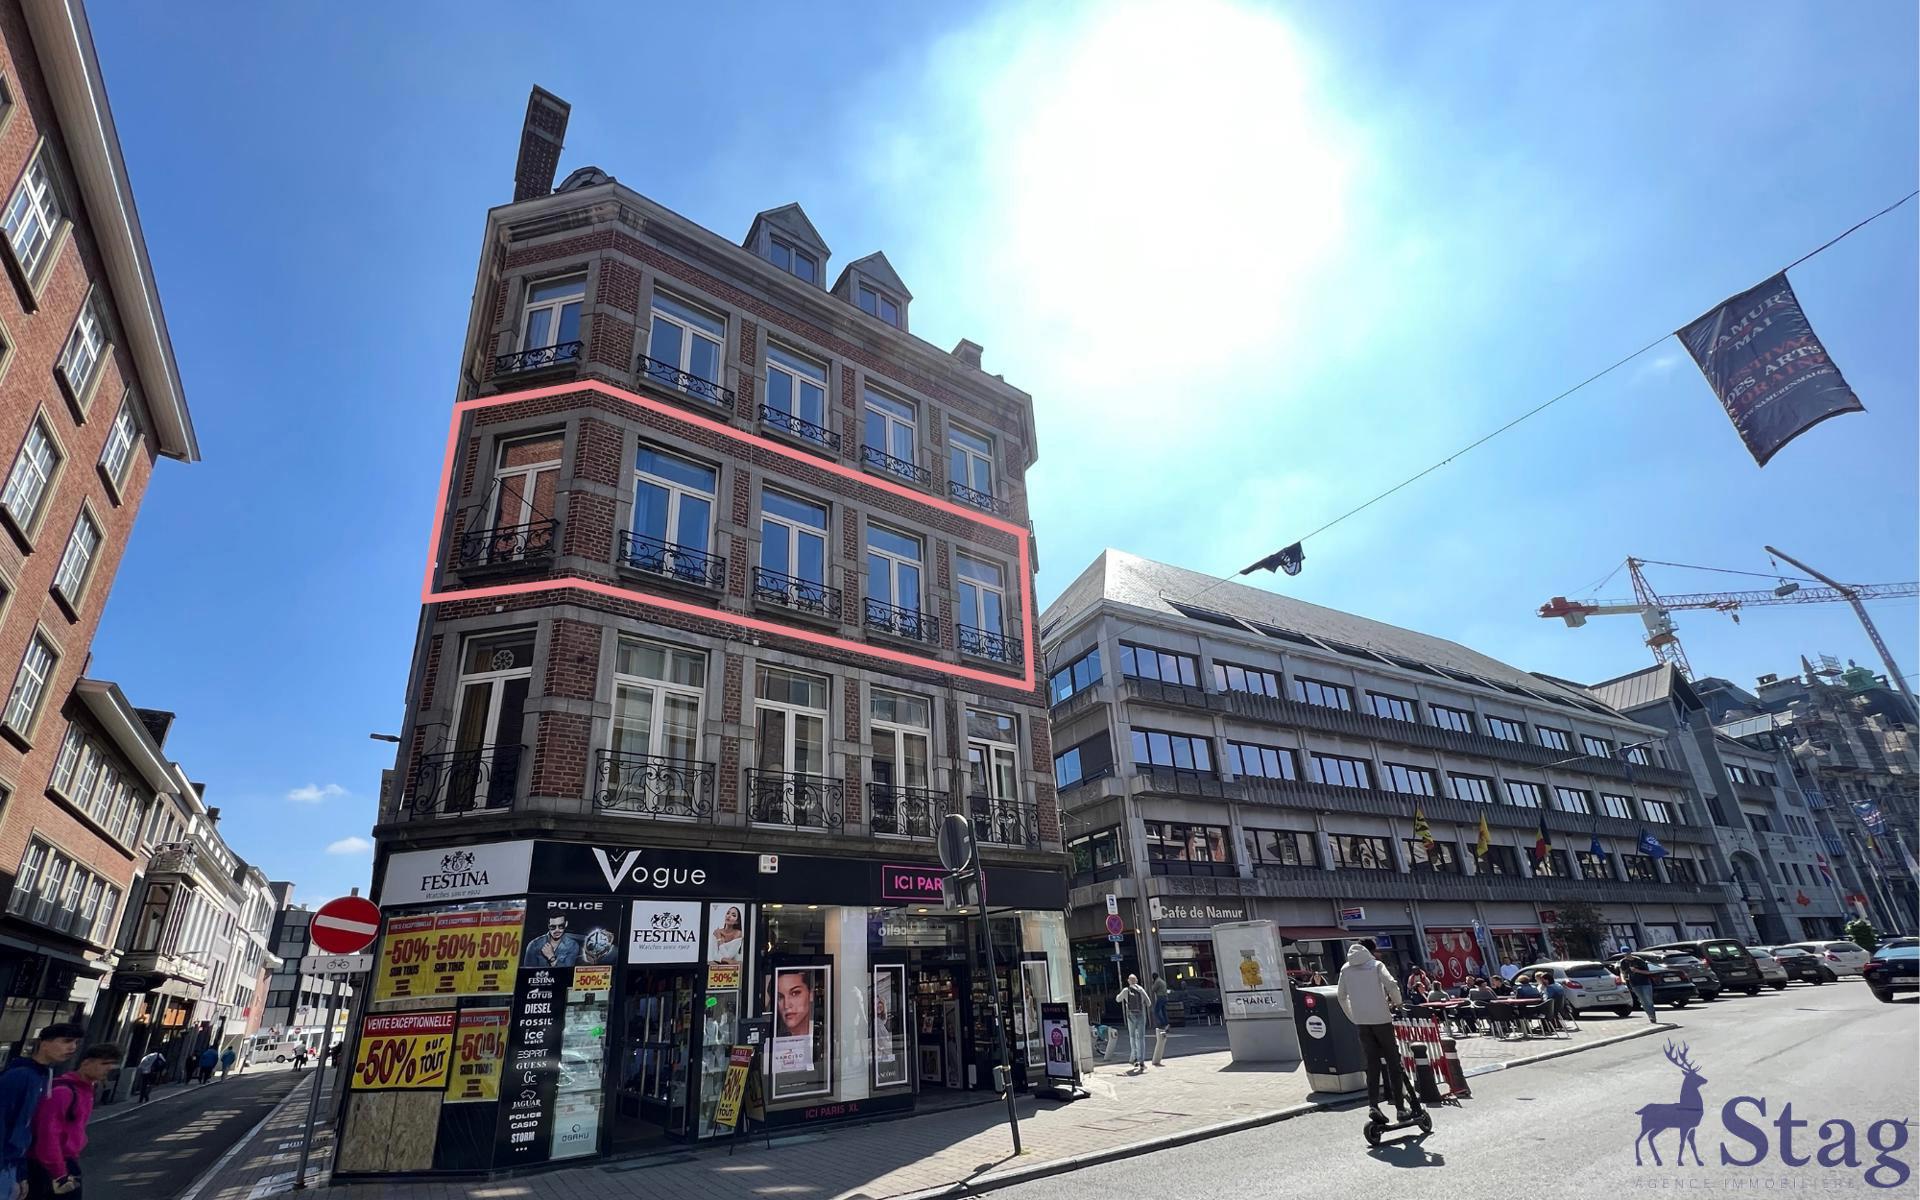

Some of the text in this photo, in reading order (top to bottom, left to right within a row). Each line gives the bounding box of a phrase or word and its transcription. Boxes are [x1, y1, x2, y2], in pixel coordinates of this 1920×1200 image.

[1712, 291, 1787, 352] AMUR
[1733, 317, 1773, 350] MAI
[1725, 345, 1822, 408] DES ARTS
[592, 847, 706, 893] Vogue
[420, 870, 489, 891] FESTINA
[894, 875, 943, 891] ICI PAR
[547, 901, 604, 911] POLICE
[1160, 905, 1243, 919] Café de Namur
[633, 929, 696, 943] FESTINA
[385, 936, 430, 965] -50%
[432, 933, 476, 961] -50%
[477, 931, 520, 959] -50%
[576, 975, 602, 986] -50%
[710, 972, 733, 983] -50%
[526, 991, 553, 999] LOTUS
[1235, 996, 1277, 1006] CHANEL
[524, 1002, 552, 1014] DIESEL
[367, 1015, 452, 1031] VENTE EXCEPTIONNELLE
[519, 1018, 553, 1027] FOSSIL
[524, 1029, 545, 1040] ice
[425, 1037, 445, 1051] sur
[455, 1031, 505, 1061] -50%
[517, 1048, 549, 1059] ESPRIT
[356, 1037, 417, 1085] -50%
[420, 1050, 446, 1075] TOUT
[515, 1060, 548, 1070] GUESS
[523, 1070, 537, 1083] Gc
[511, 1099, 542, 1110] JAGUAR
[805, 1103, 859, 1120] ICI PARIS XL
[509, 1112, 542, 1120] POLICE
[719, 1108, 734, 1117] TOUT
[510, 1120, 538, 1129] CASIO
[511, 1131, 536, 1144] STORM
